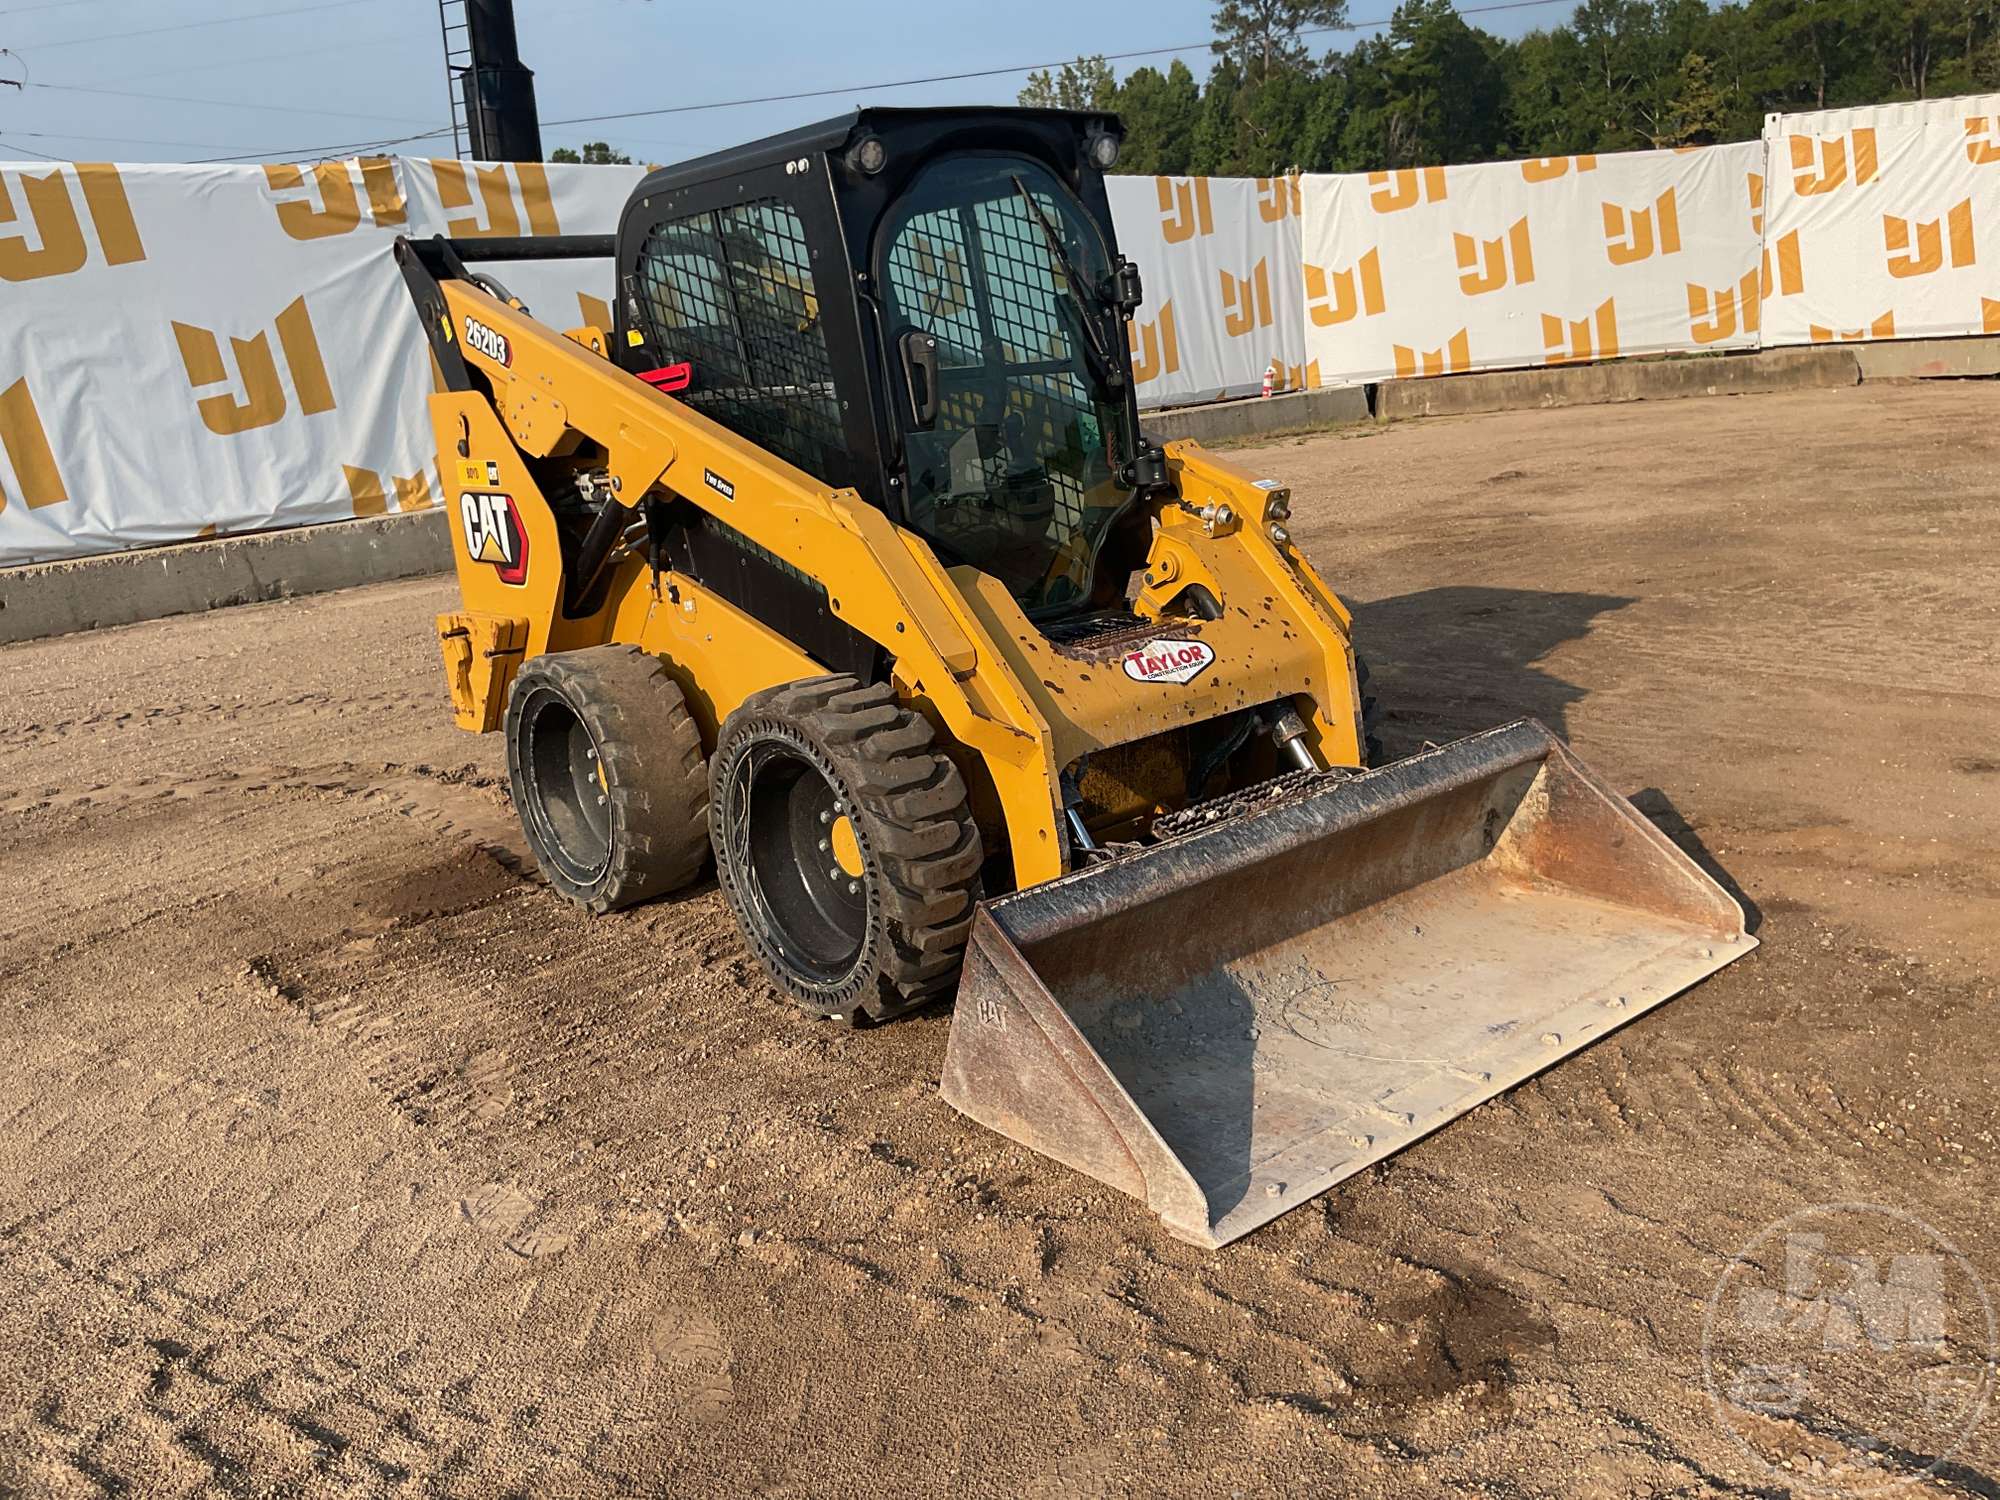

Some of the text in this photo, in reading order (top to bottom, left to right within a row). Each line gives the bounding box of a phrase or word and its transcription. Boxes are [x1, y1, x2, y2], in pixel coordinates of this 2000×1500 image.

[465, 316, 506, 365] 262D3
[461, 493, 512, 563] CAT
[1127, 645, 1206, 676] TAYLOR
[1147, 665, 1189, 679] CONSTRUCTION
